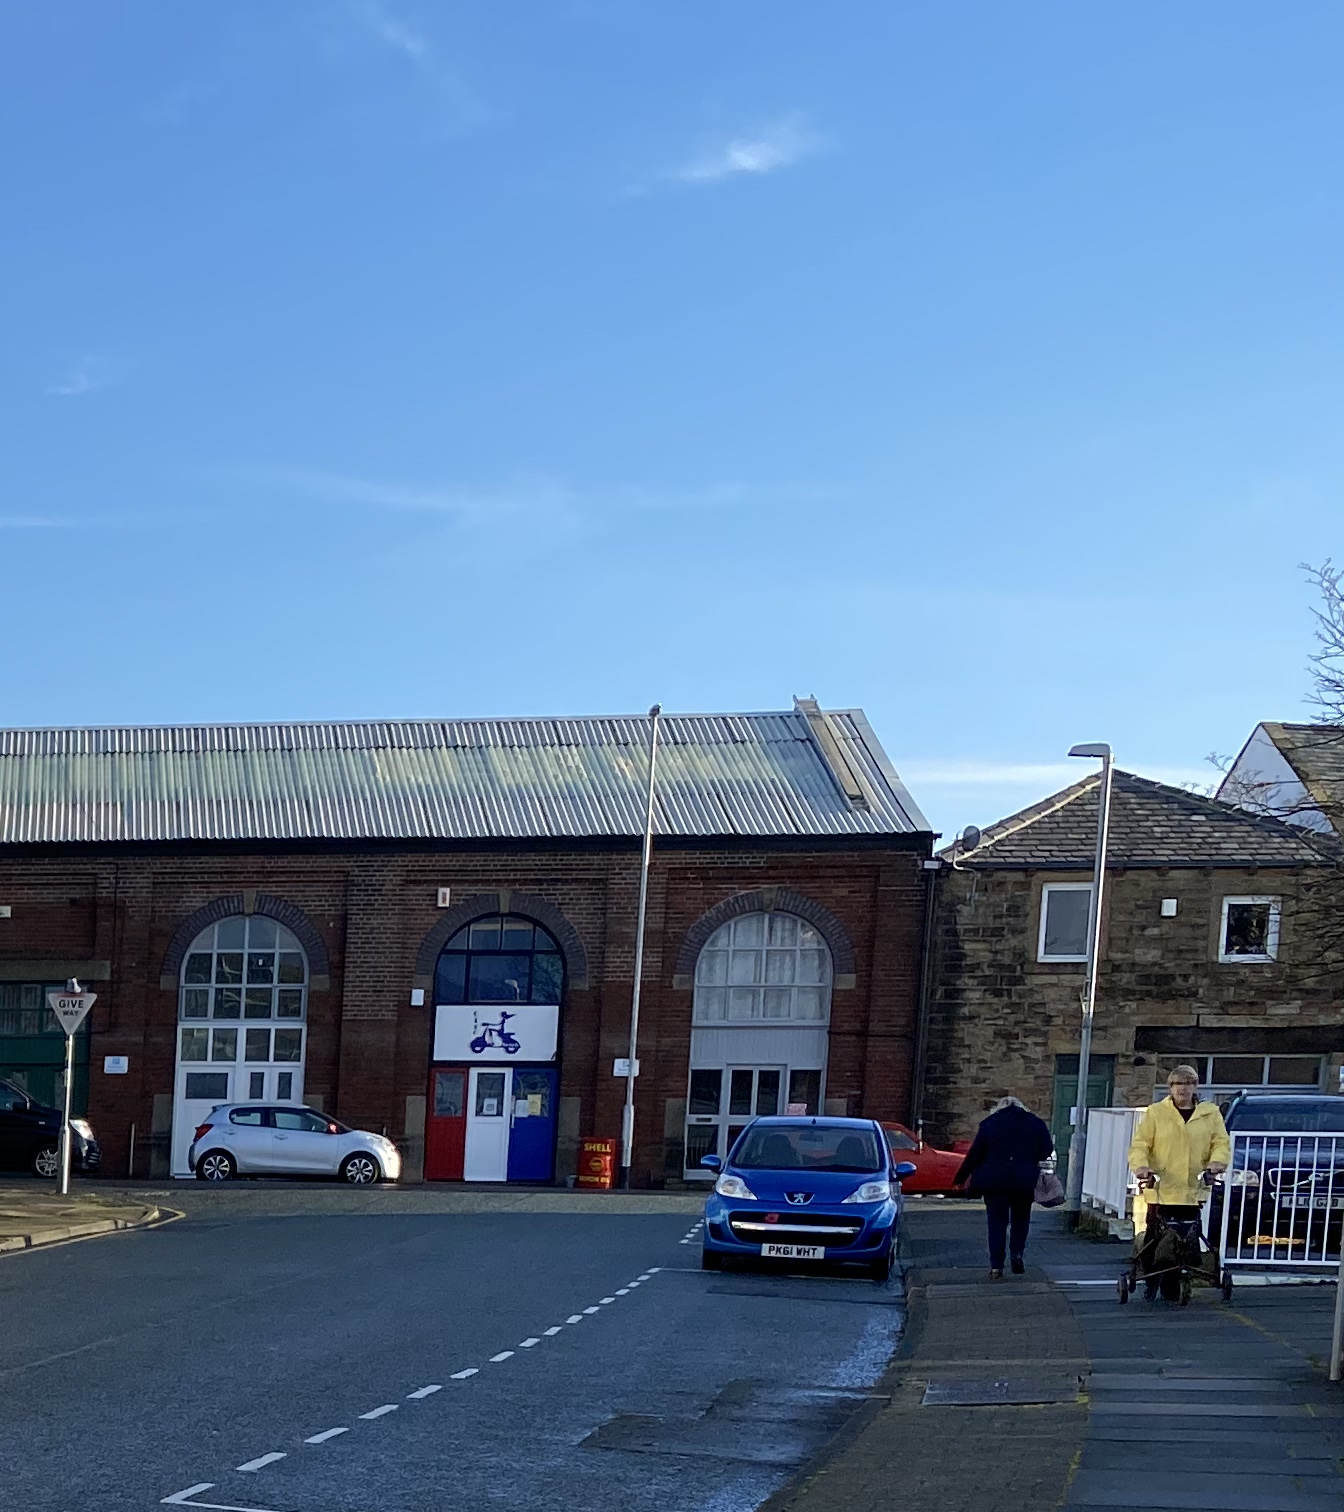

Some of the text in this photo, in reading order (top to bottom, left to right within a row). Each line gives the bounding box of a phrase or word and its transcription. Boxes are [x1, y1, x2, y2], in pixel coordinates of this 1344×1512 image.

[58, 1000, 84, 1008] GIVE
[584, 1143, 611, 1152] SHELL
[768, 1245, 817, 1257] PK61 WHT
